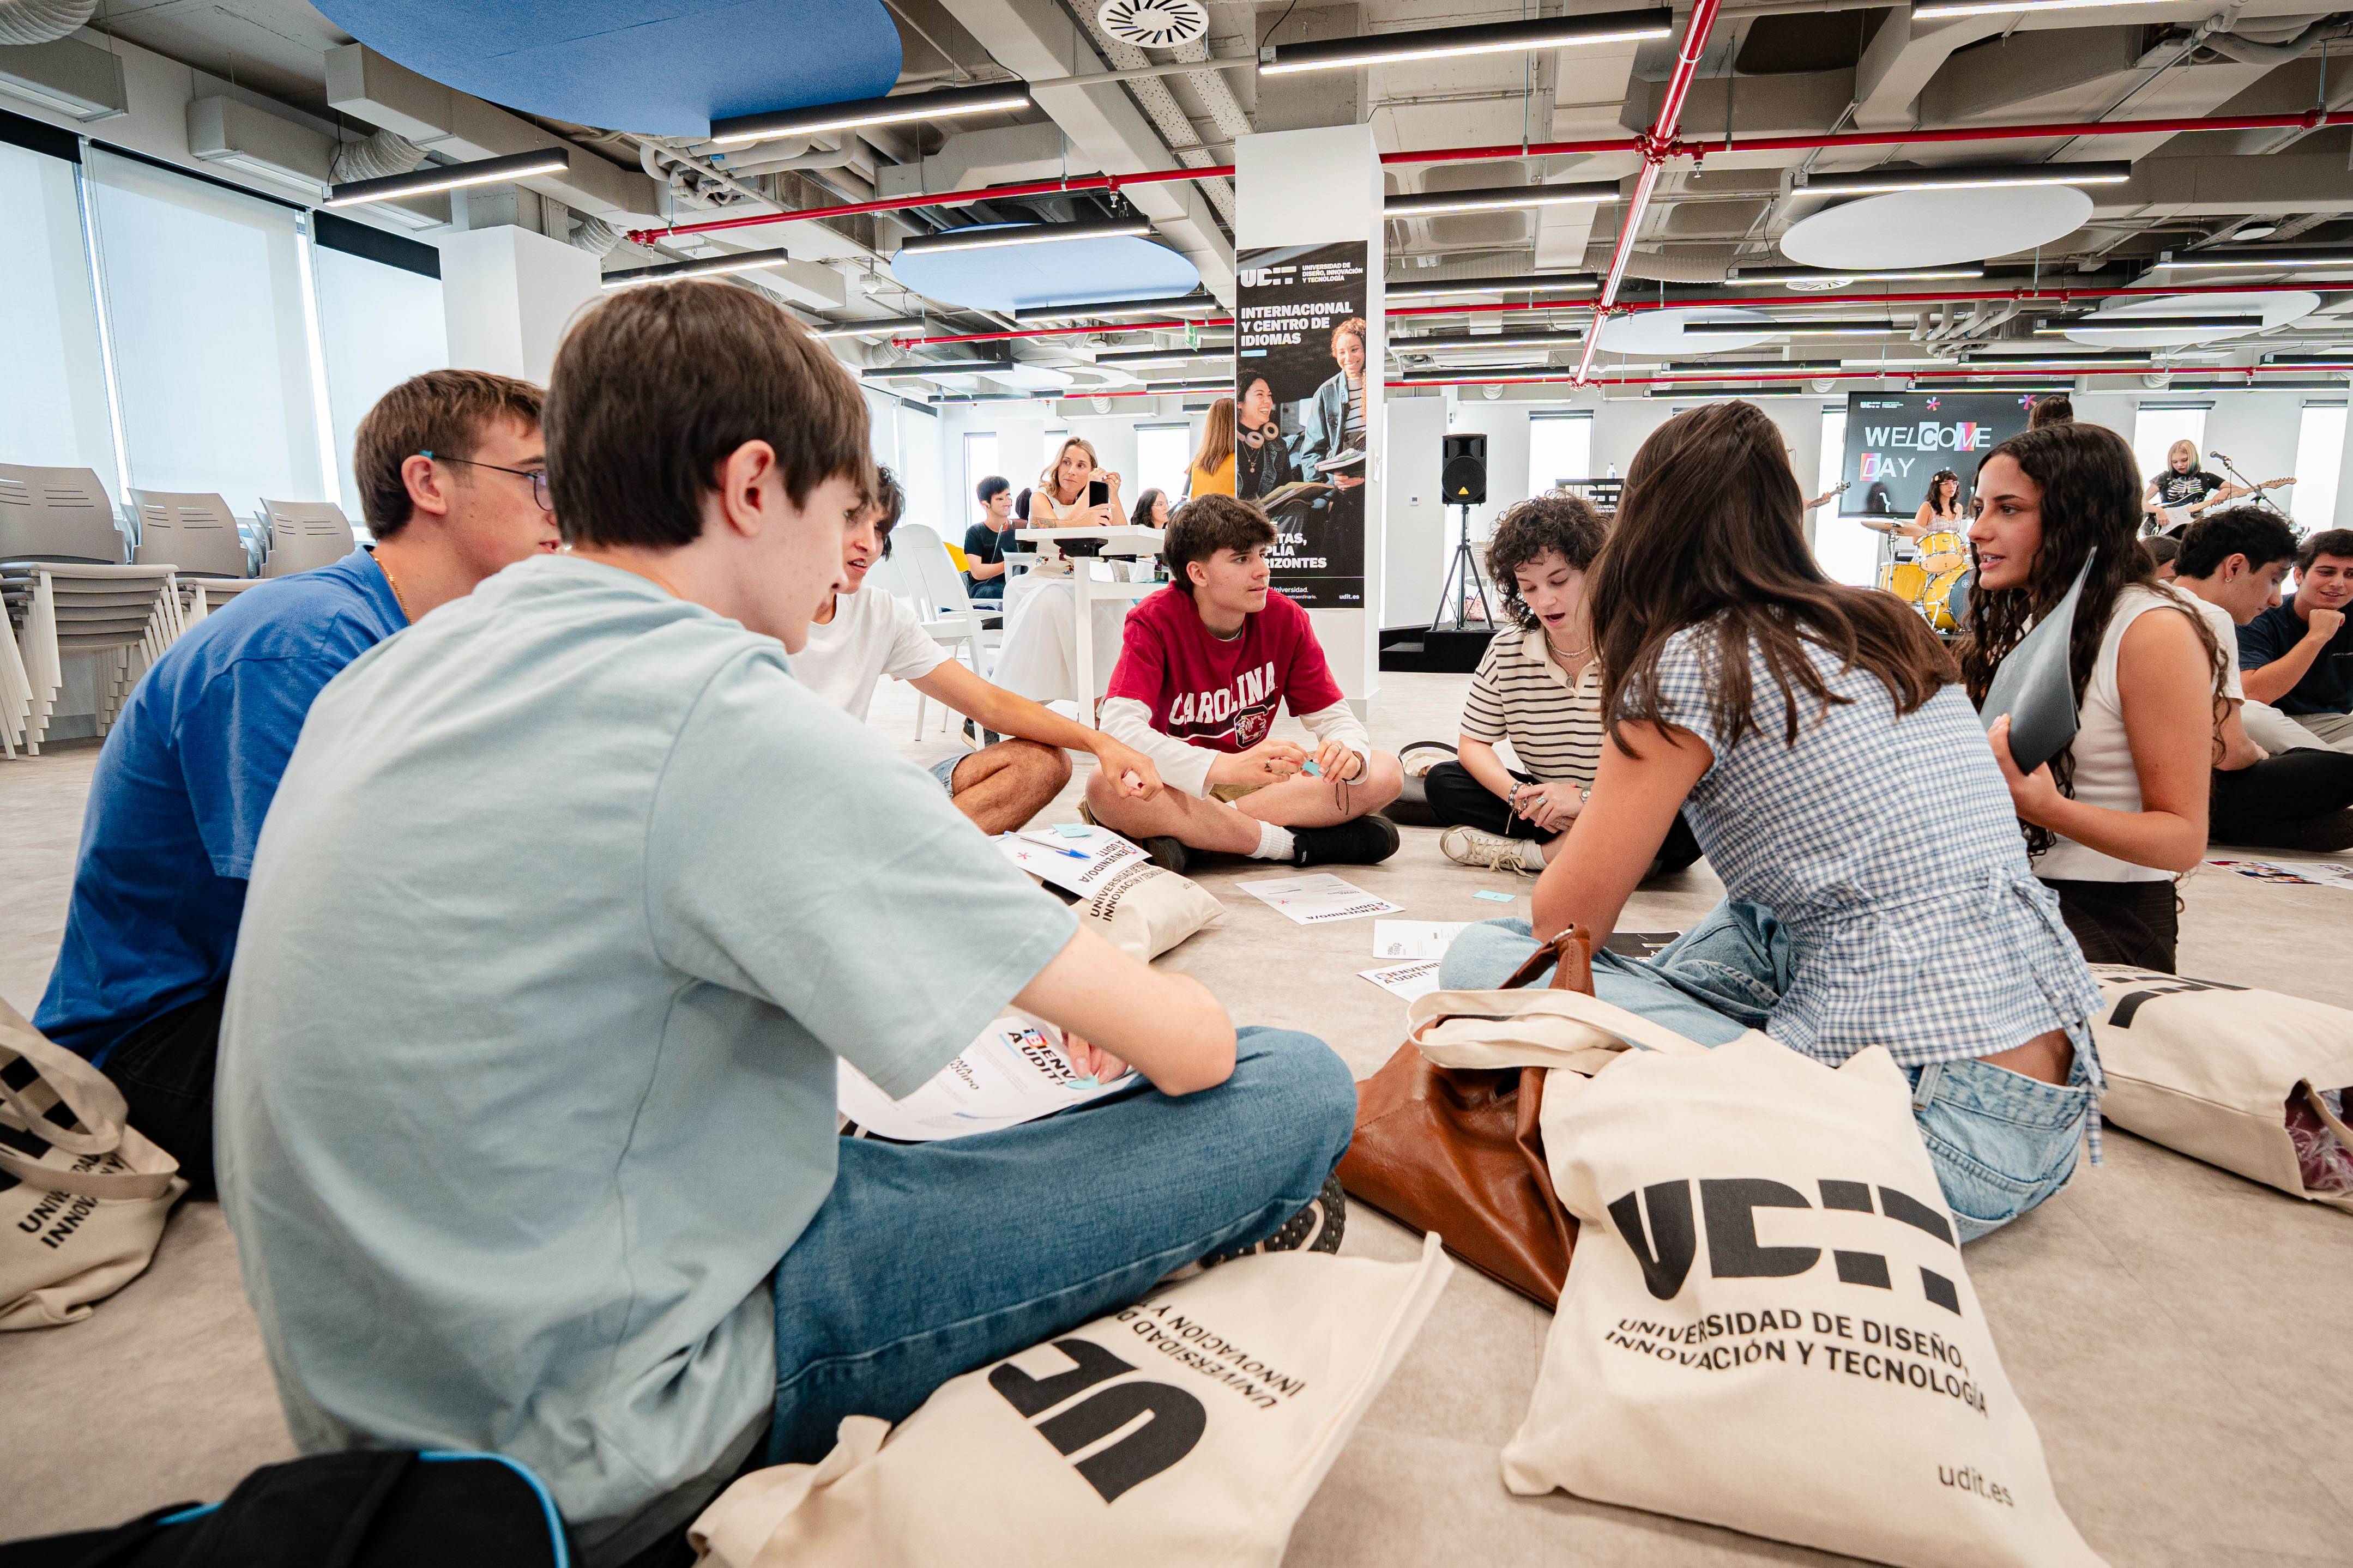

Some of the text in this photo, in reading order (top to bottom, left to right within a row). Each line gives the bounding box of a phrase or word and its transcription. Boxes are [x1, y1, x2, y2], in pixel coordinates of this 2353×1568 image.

[1240, 266, 1297, 287] UDIT
[1307, 275, 1345, 283] TECNOLOGÍA
[1326, 268, 1363, 276] INNOVACIÓN
[1241, 301, 1354, 319] INTERNACIONAL
[1241, 317, 1330, 332] Y CENTRO DE
[1241, 332, 1301, 347] IDIOMAS
[1865, 427, 1992, 448] WELCOME
[1862, 458, 1915, 478] DAY
[1276, 532, 1307, 546] TAS,
[1266, 544, 1295, 556] PLÍA
[1265, 558, 1327, 568] RIZONTES
[1168, 661, 1275, 725] CAROLINA
[1007, 1032, 1023, 1044] A
[1022, 1046, 1065, 1086] UDIT!
[951, 1062, 979, 1090] QUIPO
[1607, 1178, 1963, 1317] UDIT
[1618, 1309, 1970, 1377] UNIVERSIDAD DE DISEÑO,
[1117, 1309, 1278, 1410] UNIVERSIDAD D
[1167, 1316, 1306, 1398] INNOVACIÓN
[1604, 1330, 1990, 1419] INNOVACIÓN Y TECNOLOGÍA
[1938, 1464, 2014, 1508] udit.es
